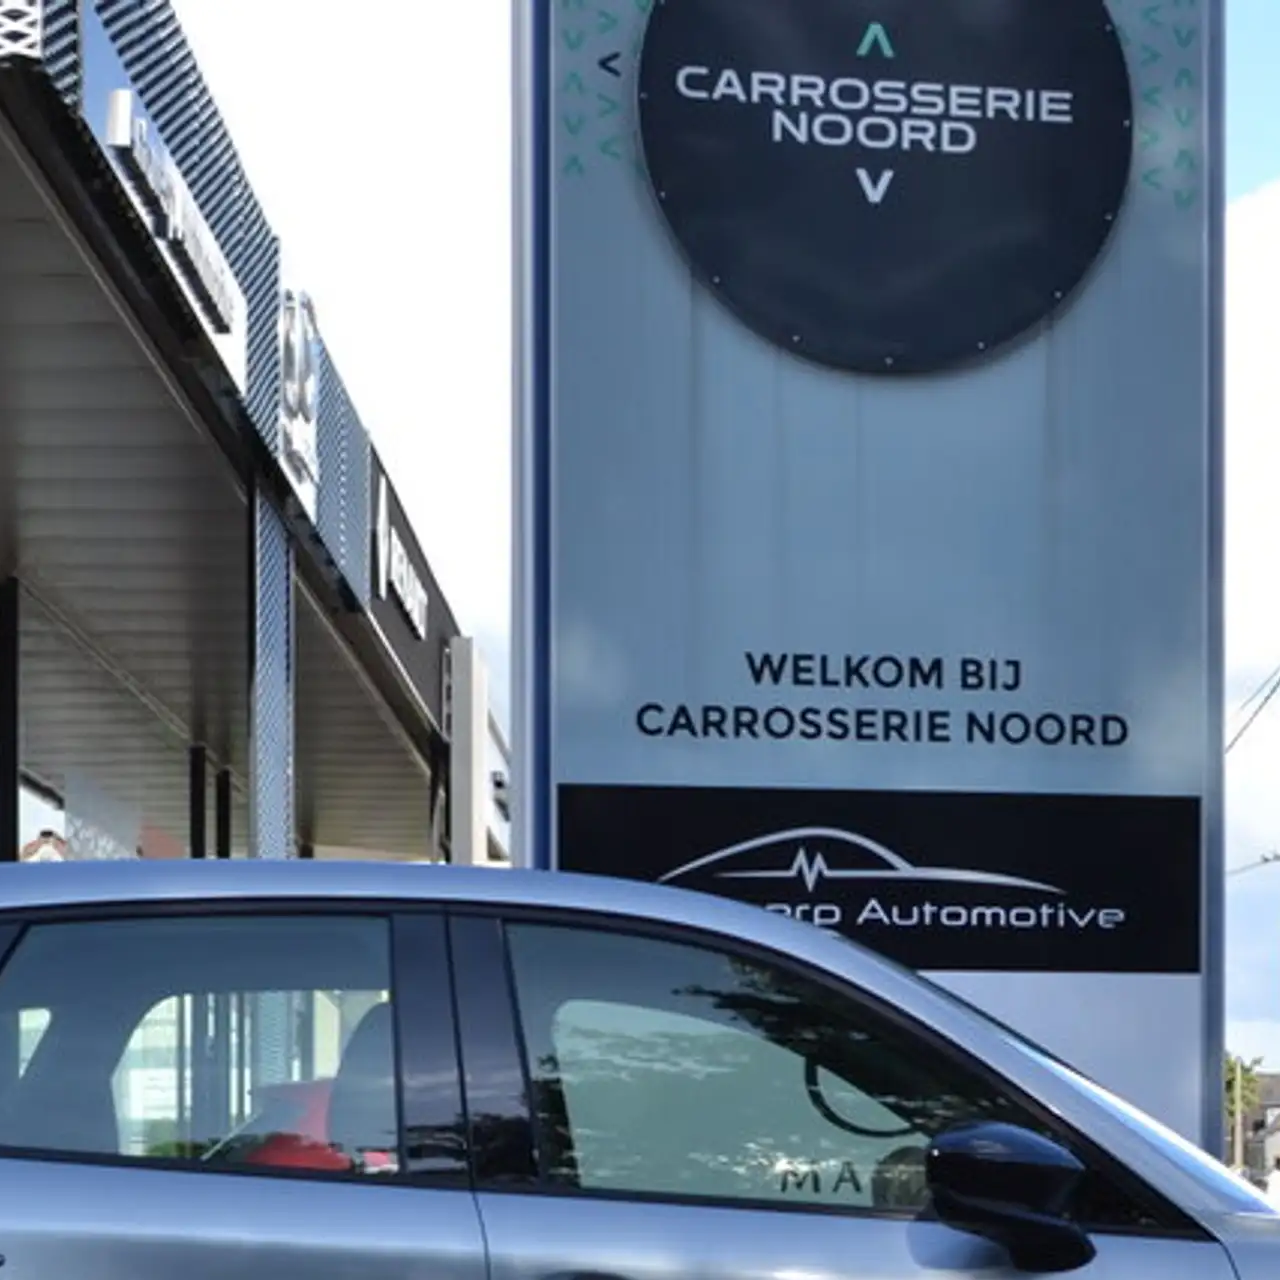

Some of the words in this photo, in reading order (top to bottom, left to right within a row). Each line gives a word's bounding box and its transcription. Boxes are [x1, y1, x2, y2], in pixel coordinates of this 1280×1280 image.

[676, 65, 1073, 123] CARROSSERIE
[772, 110, 977, 153] NOORD
[745, 652, 943, 690] WELKOM
[960, 658, 1022, 692] BIJ
[636, 704, 952, 742] CARROSSERIE
[967, 711, 1129, 746] NOORD
[856, 897, 1125, 929] Automotive
